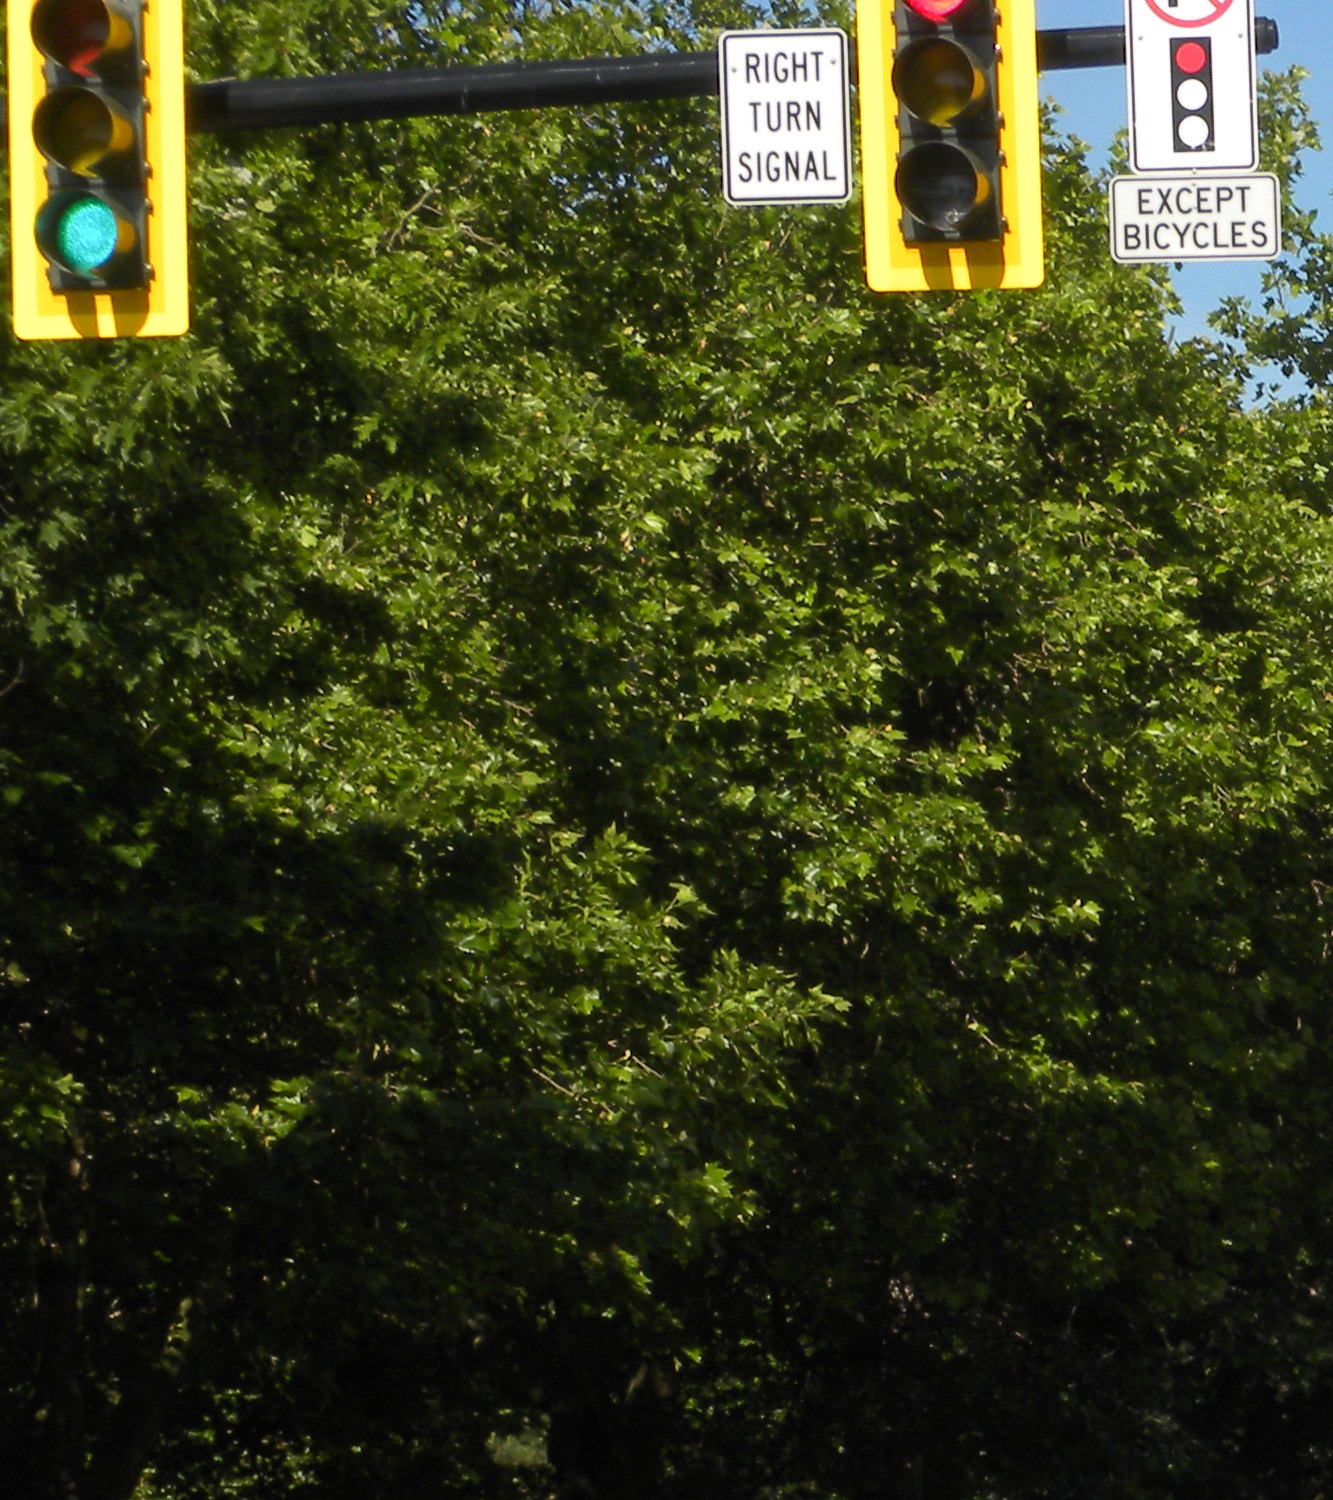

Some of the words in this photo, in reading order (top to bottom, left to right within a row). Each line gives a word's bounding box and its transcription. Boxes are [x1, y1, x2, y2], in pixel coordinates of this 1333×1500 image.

[745, 51, 824, 84] RIGHT
[748, 100, 821, 133] TURN
[738, 149, 837, 183] SIGNAL
[1137, 186, 1251, 215] EXCEPT
[1123, 220, 1268, 250] BICYCLES
